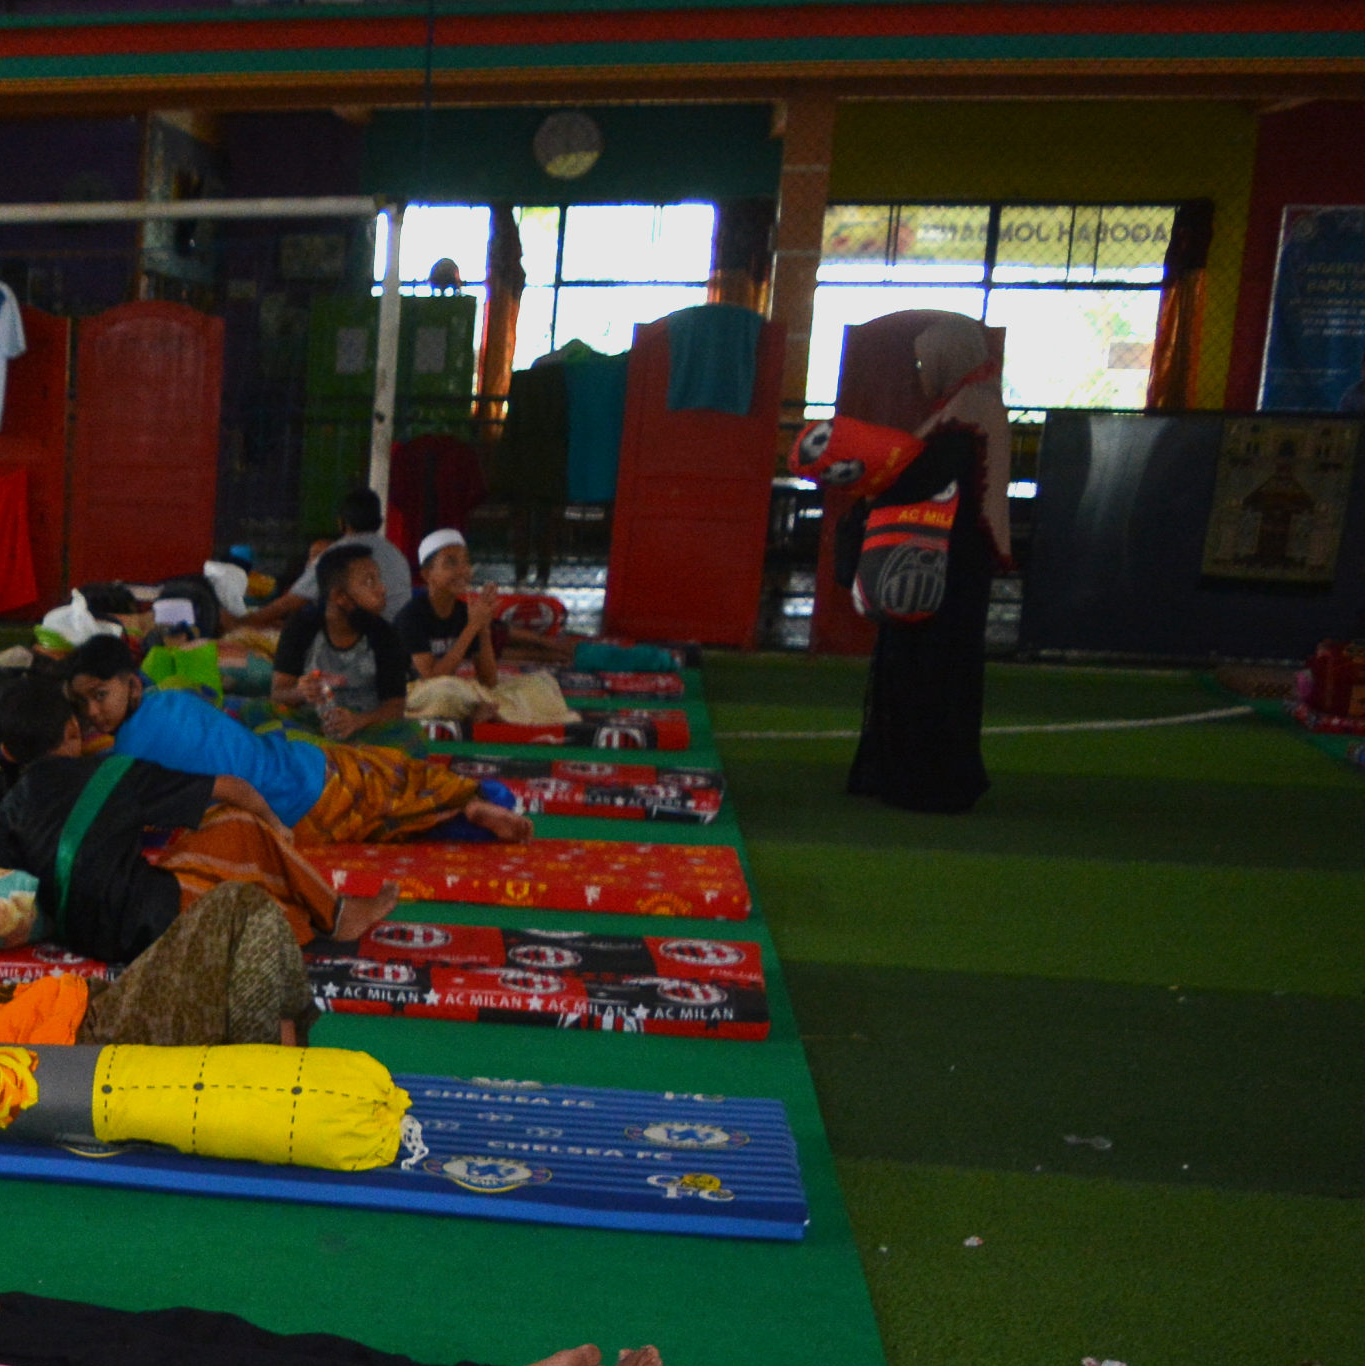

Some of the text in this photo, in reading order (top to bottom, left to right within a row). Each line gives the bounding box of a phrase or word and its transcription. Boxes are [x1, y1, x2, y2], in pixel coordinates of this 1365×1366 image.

[344, 986, 368, 999] AC
[371, 987, 419, 1003] MILAN
[445, 993, 468, 1006] AC
[470, 993, 522, 1009] MILAN
[574, 1000, 627, 1017] MILAN
[655, 1007, 676, 1019] AC
[679, 1007, 734, 1021] MILAN
